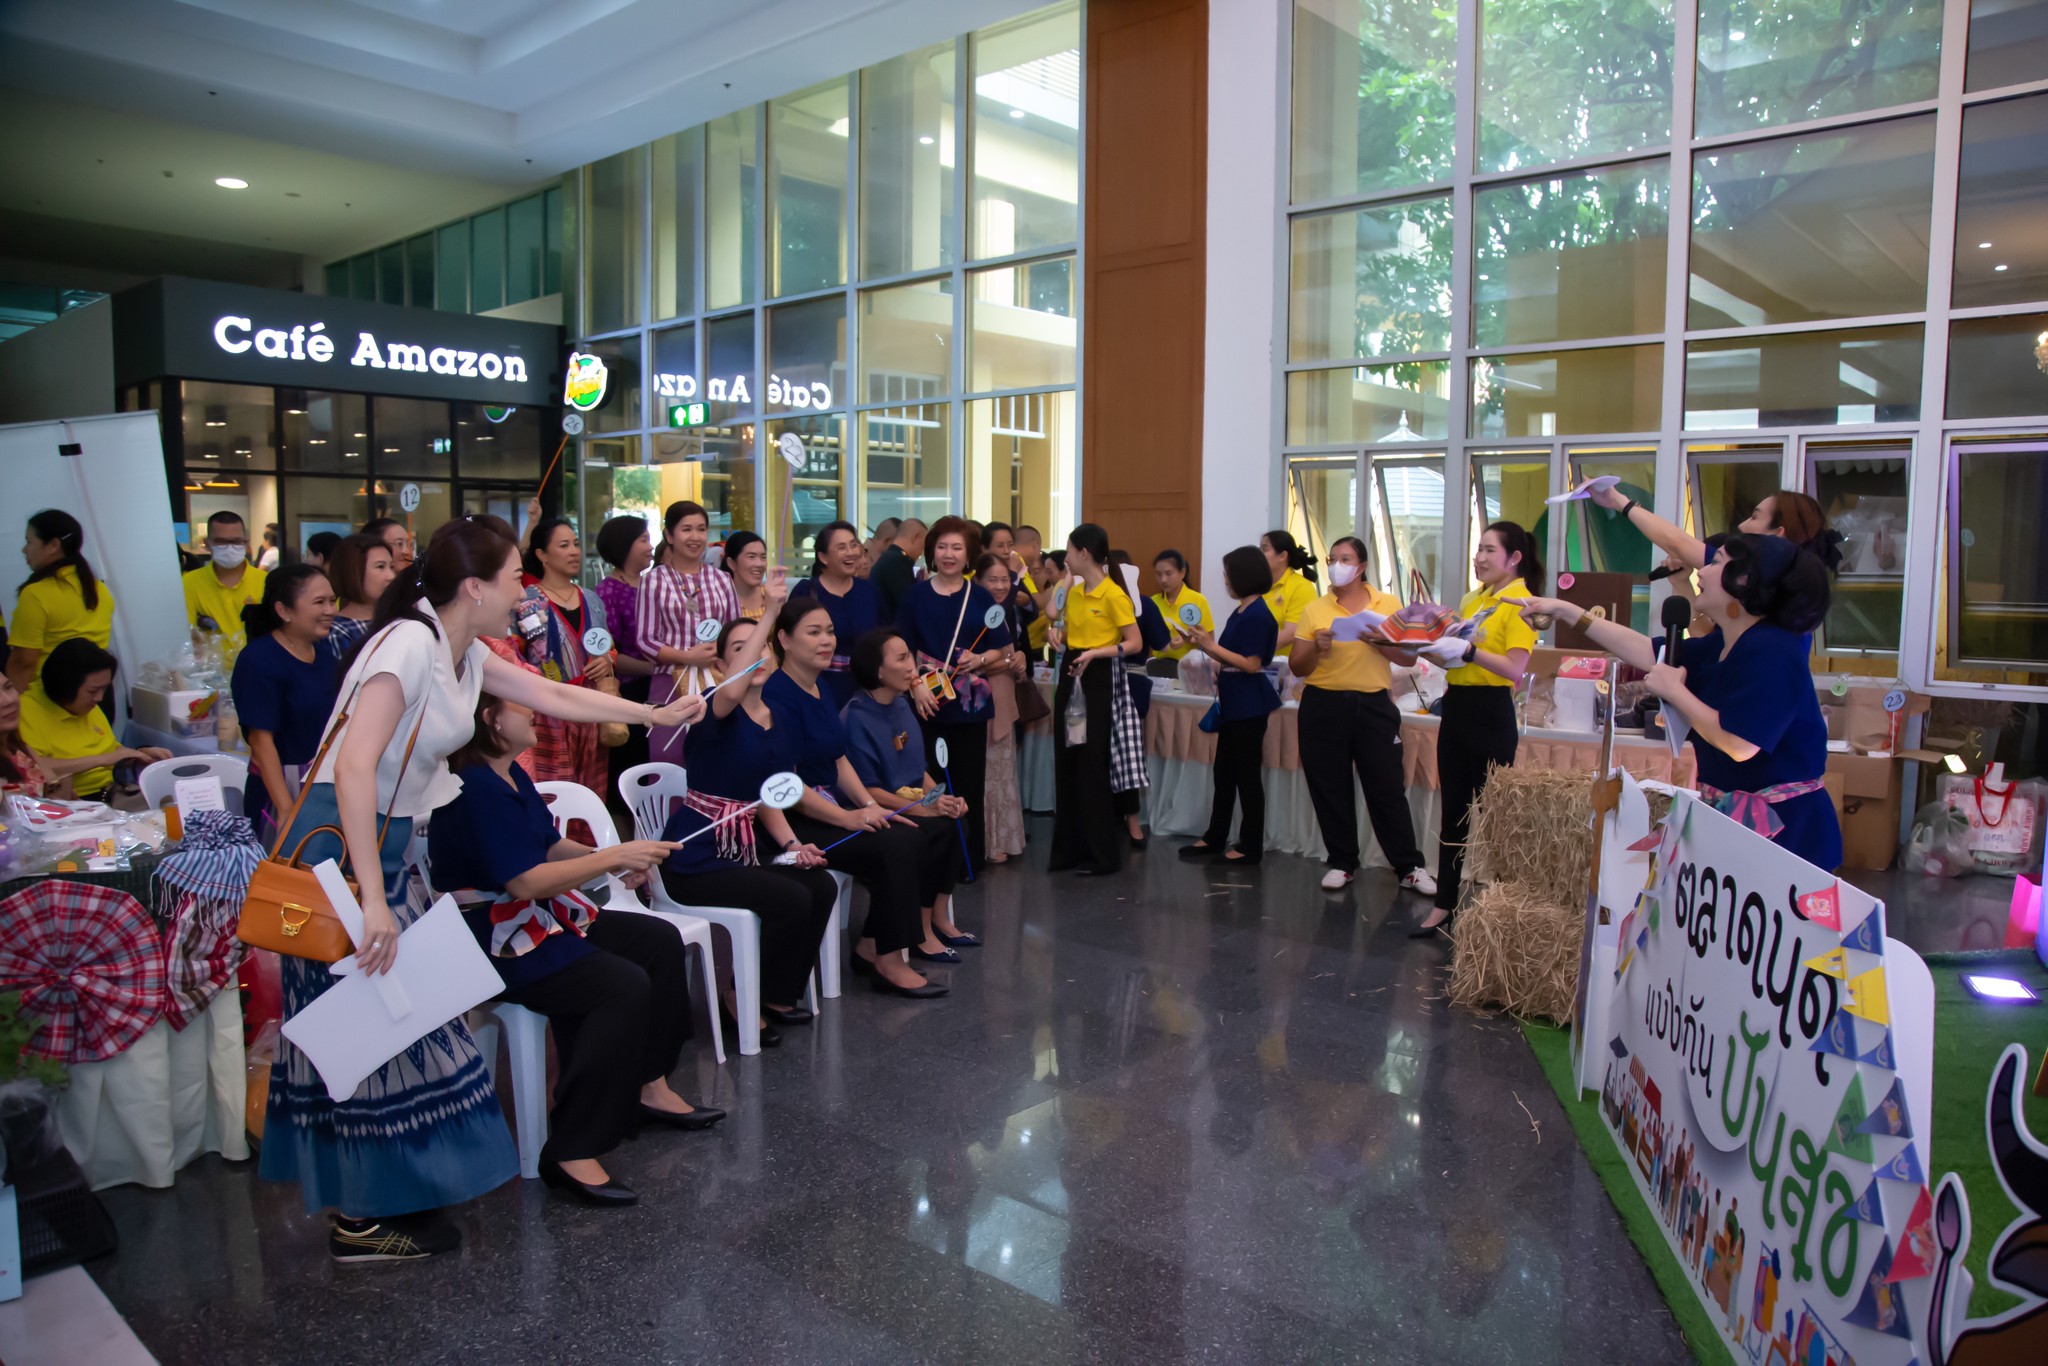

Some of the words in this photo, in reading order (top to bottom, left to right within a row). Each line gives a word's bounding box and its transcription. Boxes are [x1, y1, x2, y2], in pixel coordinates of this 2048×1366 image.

[214, 315, 335, 363] Café
[350, 332, 528, 382] Amazon
[403, 488, 419, 507] 12
[699, 622, 716, 638] 11
[586, 631, 608, 652] 36
[1885, 693, 1904, 708] 23
[767, 776, 801, 803] 18
[1721, 1010, 1859, 1297] ปันสุข
